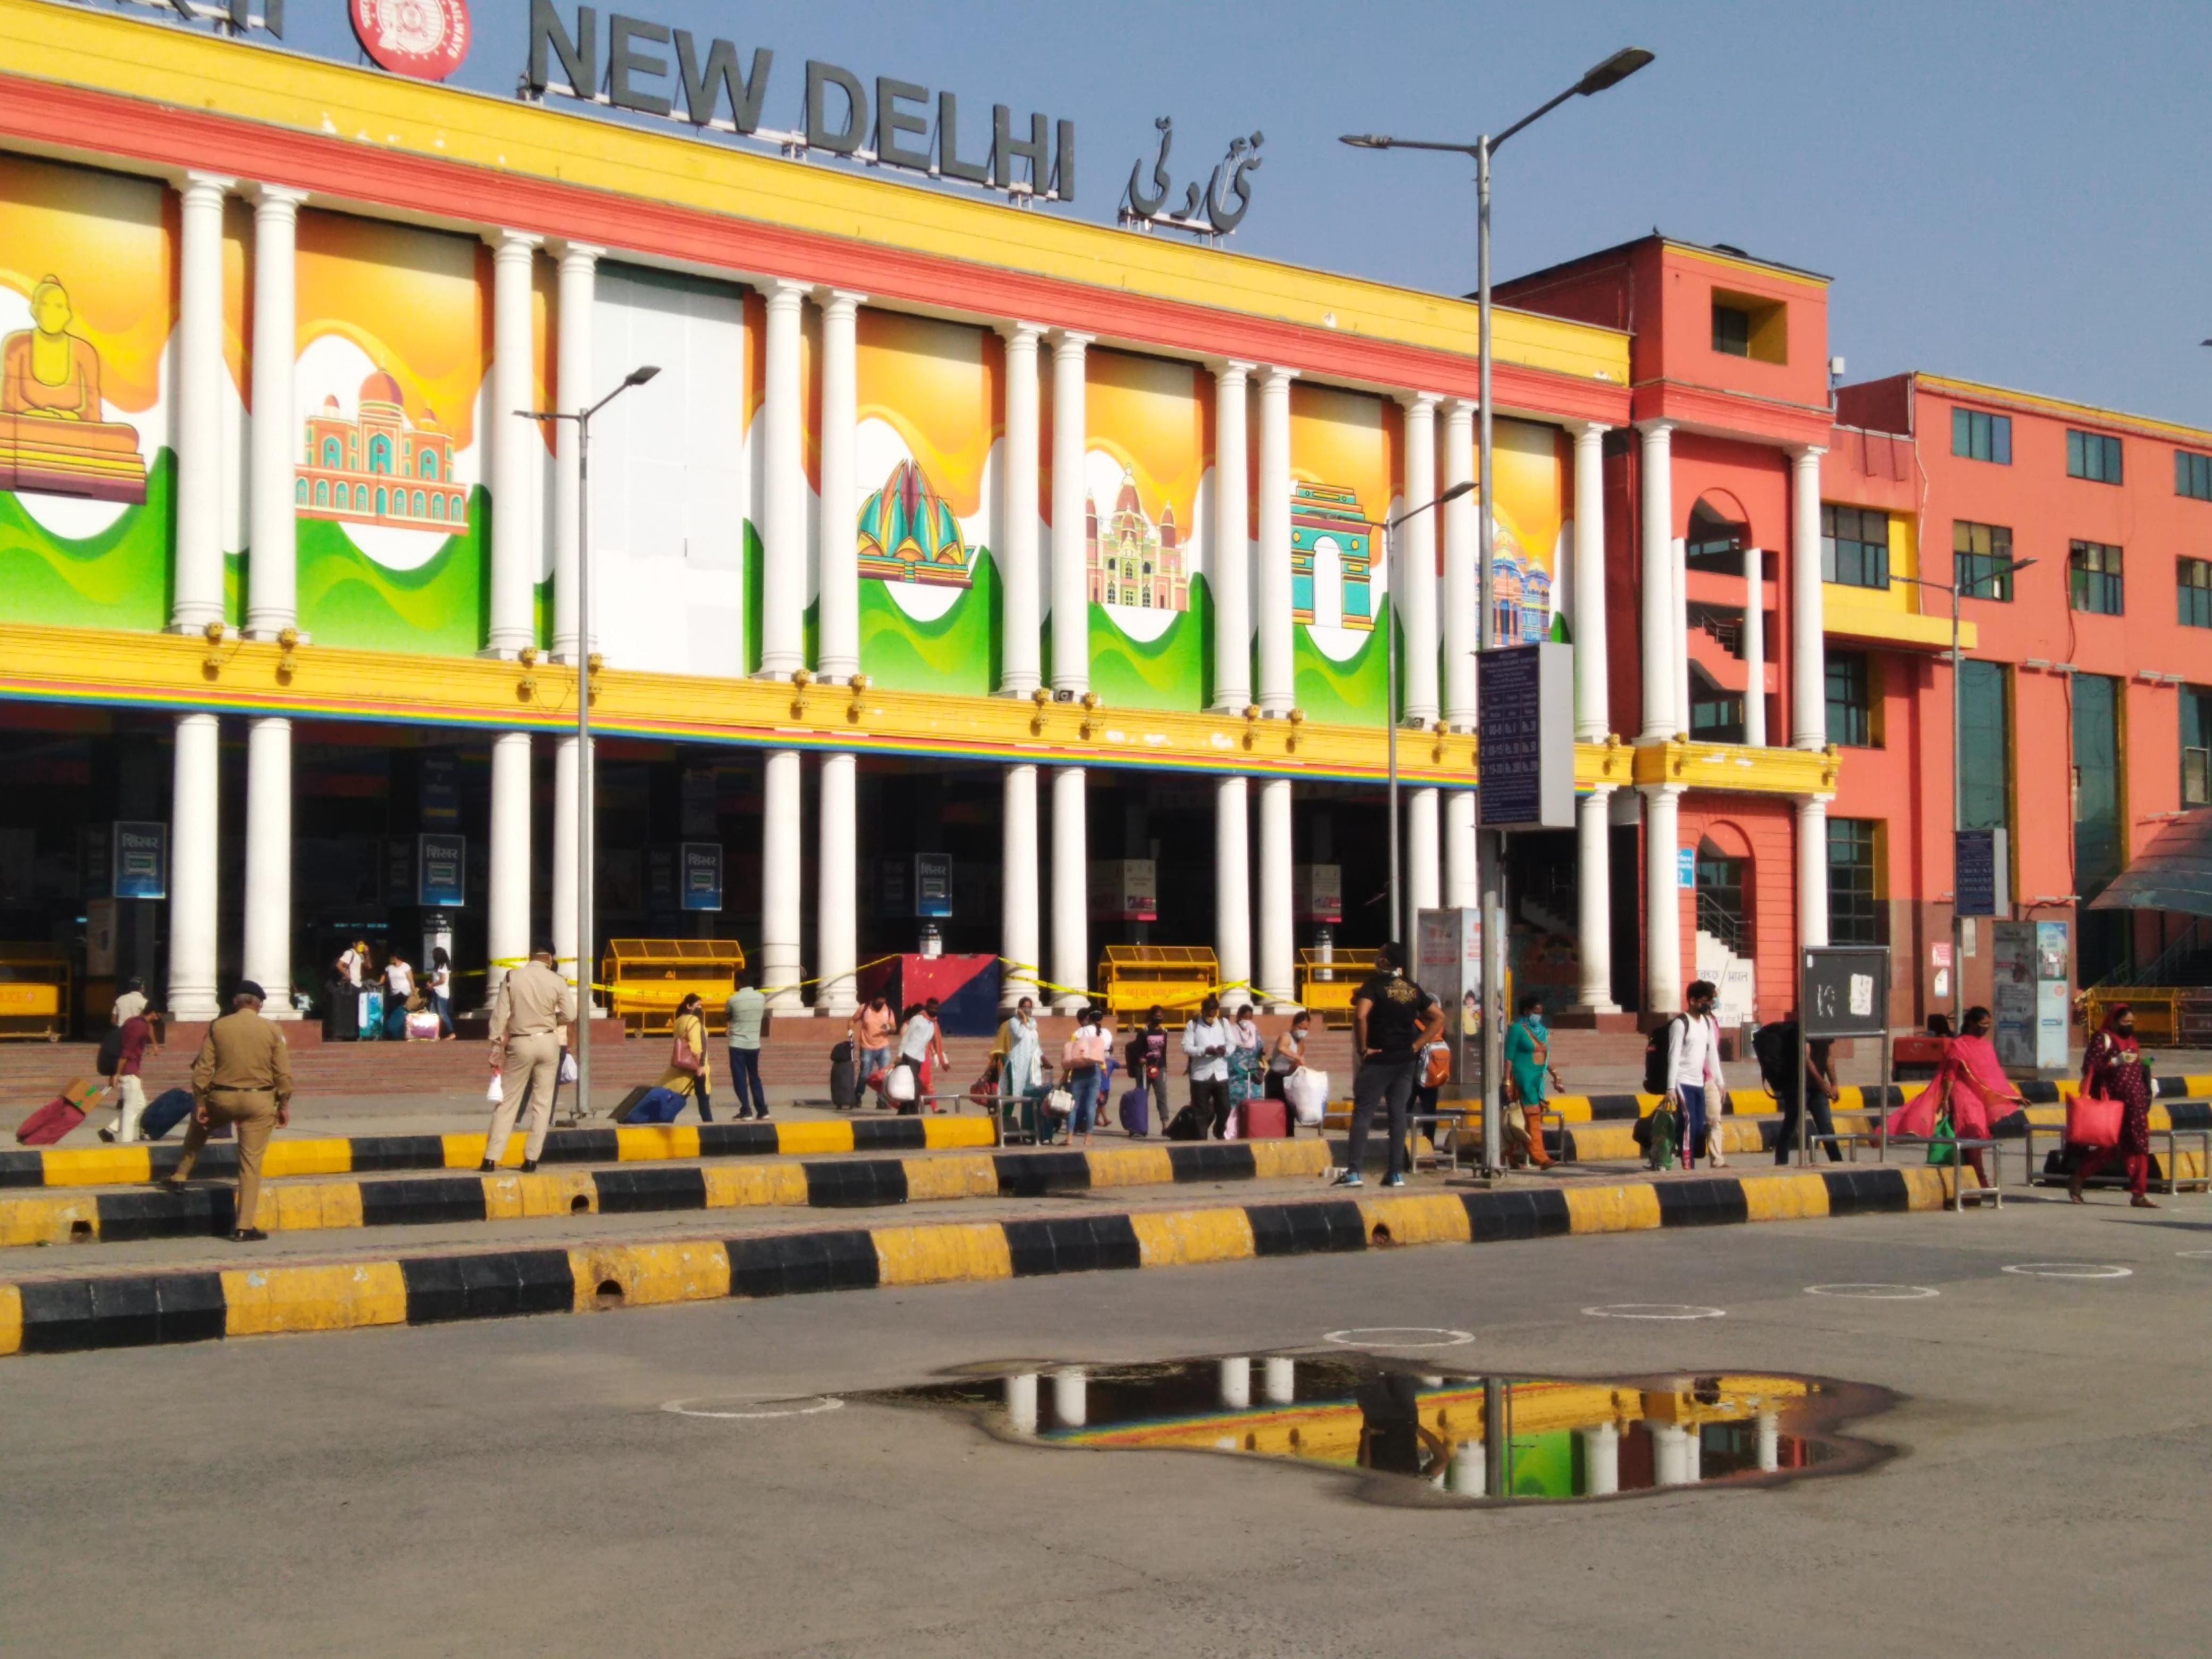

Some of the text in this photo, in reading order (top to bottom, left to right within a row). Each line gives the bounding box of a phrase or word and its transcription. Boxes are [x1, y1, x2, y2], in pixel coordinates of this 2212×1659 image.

[448, 0, 464, 58] AILWAYS
[530, 0, 1074, 202] NEW DELHI
